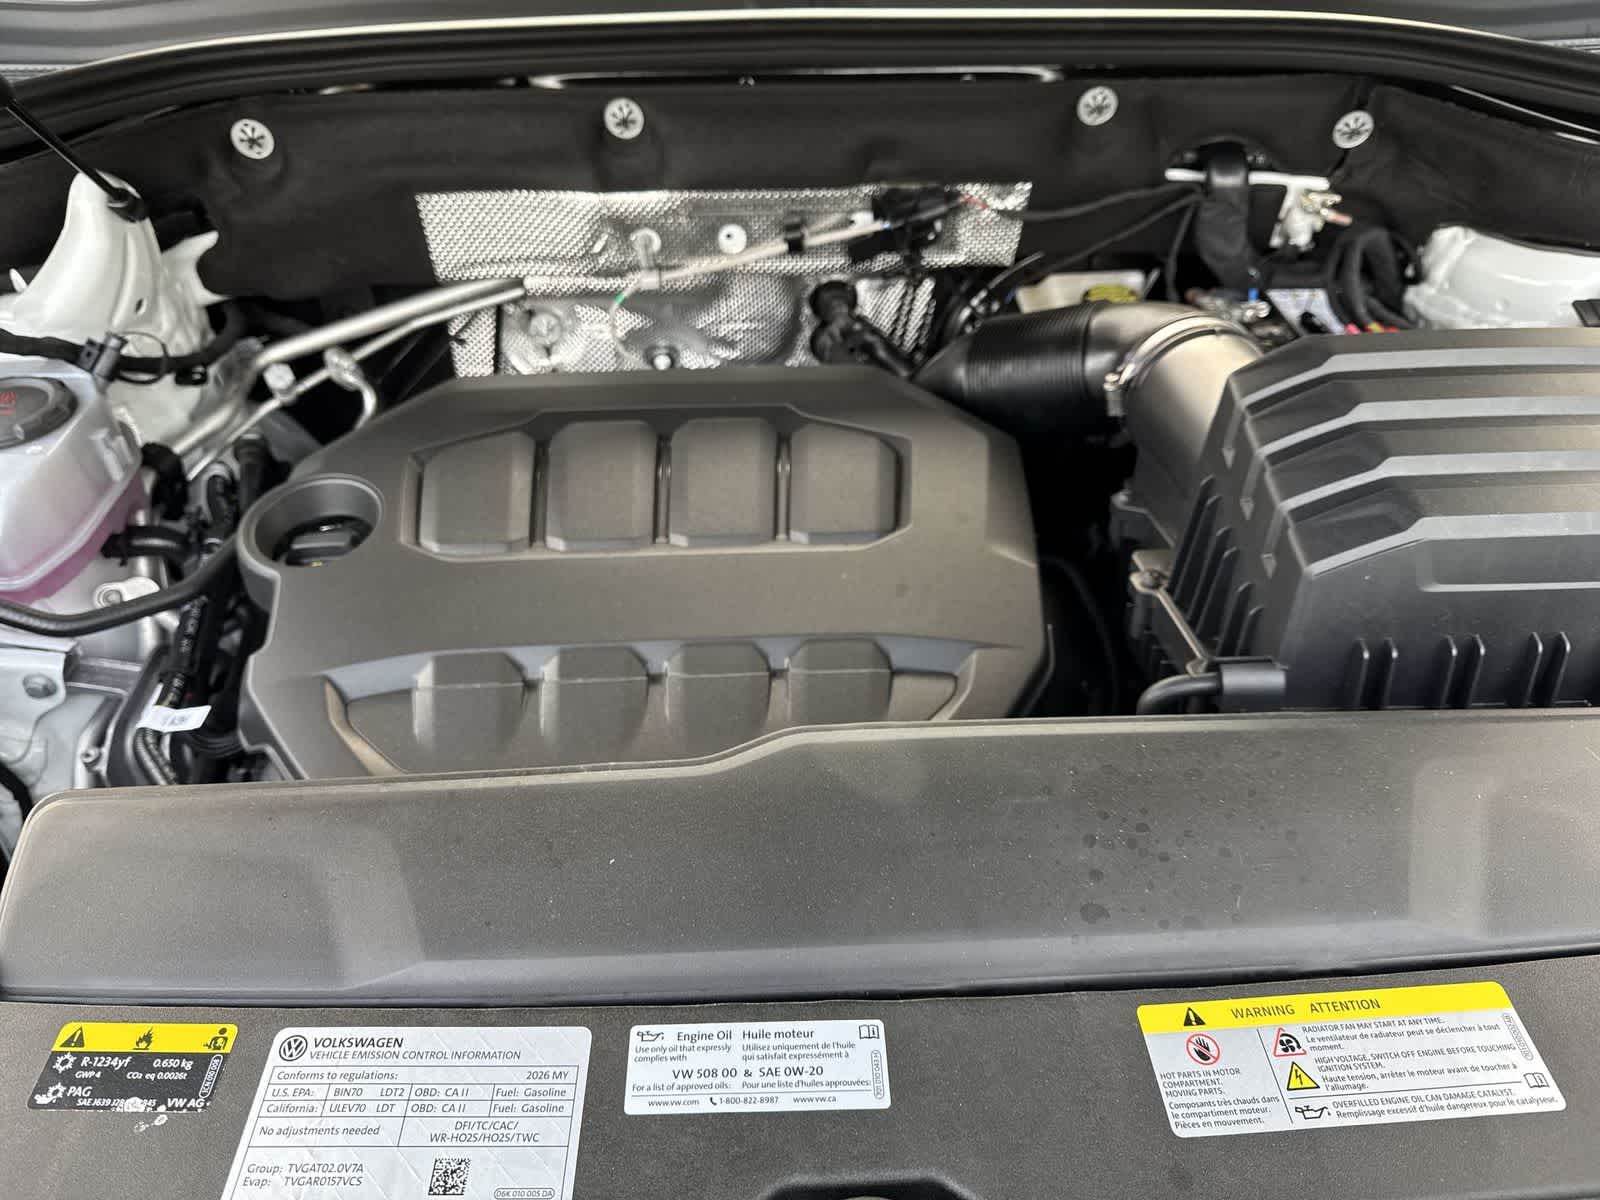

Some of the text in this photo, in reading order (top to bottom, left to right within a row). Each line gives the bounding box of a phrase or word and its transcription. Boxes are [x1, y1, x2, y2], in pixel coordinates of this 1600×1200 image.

[1231, 1000, 1381, 1018] WARNING ATTENTION
[1373, 1020, 1396, 1028] START
[678, 1030, 732, 1043] Engine Oil
[743, 1030, 815, 1039] Huile moteur
[1316, 1034, 1357, 1042] ventilateur
[1370, 1031, 1404, 1039] radiateur
[1407, 1029, 1423, 1037] peut
[1435, 1025, 1476, 1034] déclencher
[314, 1037, 403, 1048] VOLKSWAGEN
[772, 1042, 820, 1051] uniquement
[651, 1046, 667, 1054] only
[697, 1044, 731, 1054] expressly
[1315, 1056, 1333, 1064] HIGH
[1371, 1052, 1400, 1060] SWITCH
[1417, 1048, 1446, 1057] ENGINE
[1446, 1046, 1476, 1054] BEFORE
[1477, 1043, 1516, 1052] TOUCHING
[310, 1051, 521, 1059] VEHICLE EMISSION CONTROL INFORMATION
[634, 1055, 668, 1064] complies
[742, 1053, 754, 1061] qui
[756, 1052, 786, 1060] satisfait
[789, 1052, 842, 1060] expressément
[80, 1056, 132, 1070] R-1234yf
[153, 1059, 193, 1070] 0.650 kg
[672, 1066, 824, 1079] VW 508 00 & SAE 0W-20
[1317, 1064, 1352, 1072] IGNITION
[1417, 1068, 1445, 1076] moteur
[1481, 1063, 1510, 1071] toucher
[145, 1073, 155, 1081] eq
[277, 1071, 398, 1082] Conforms to regulations:
[526, 1071, 569, 1080] 2026 MY
[1160, 1072, 1176, 1080] HOT
[1177, 1070, 1201, 1078] PARTS
[1212, 1068, 1240, 1076] MOTOR
[653, 1083, 664, 1091] list
[666, 1083, 675, 1091] of
[675, 1082, 713, 1092] approved
[742, 1081, 759, 1089] Pour
[67, 1086, 92, 1096] PAG
[272, 1089, 314, 1097] U.S. EPA:
[334, 1088, 405, 1097] BIN70 LDT2
[414, 1088, 440, 1097] OBD:
[495, 1088, 567, 1097] Fuel: Gasoline
[1166, 1089, 1197, 1098] MOVING
[77, 1098, 91, 1106] SAE
[167, 1098, 186, 1107] VW
[187, 1098, 205, 1107] AG
[793, 1095, 836, 1103] www.vw.ca
[1168, 1100, 1216, 1110] Composants
[1217, 1098, 1232, 1106] très
[1233, 1096, 1260, 1105] chauds
[1332, 1091, 1475, 1109] OVERFILLED ENGINE OIL CAN DAMAGE
[266, 1104, 318, 1113] California:
[329, 1104, 396, 1112] ULEV70 LDT
[411, 1104, 437, 1112] OBD:
[493, 1104, 564, 1112] Fuel: Gasoline
[1336, 1108, 1385, 1118] Remplissage
[1387, 1106, 1417, 1114] excessif
[1447, 1101, 1486, 1111] dangereux
[1489, 1100, 1506, 1108] pour
[1507, 1098, 1515, 1106] le
[1181, 1110, 1237, 1120] compartiment
[455, 1121, 519, 1131] DFI/TC/CAC/
[1175, 1120, 1200, 1129] Pièces
[260, 1126, 380, 1137] No adjustments needed
[247, 1164, 283, 1176] Group:
[242, 1176, 271, 1189] Evap:
